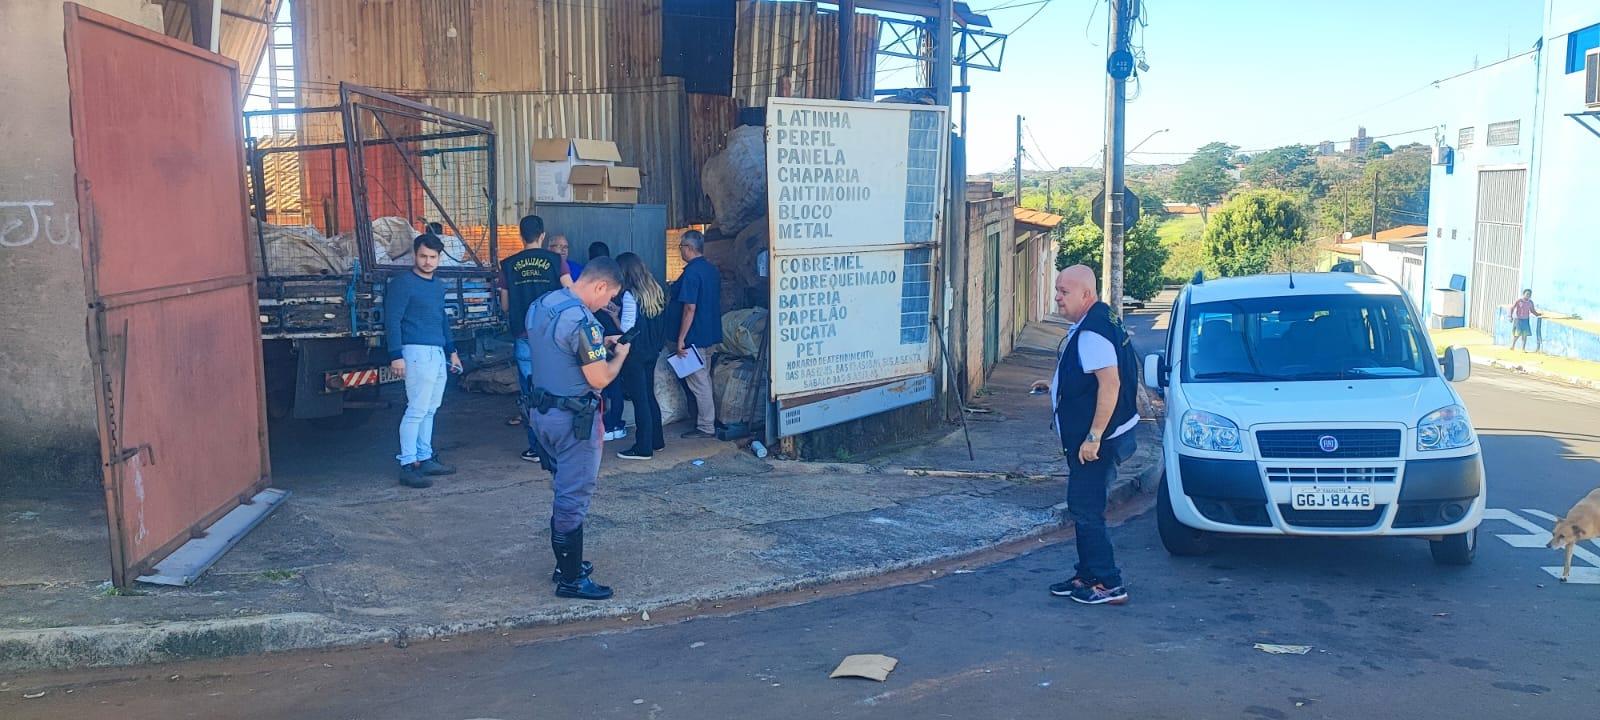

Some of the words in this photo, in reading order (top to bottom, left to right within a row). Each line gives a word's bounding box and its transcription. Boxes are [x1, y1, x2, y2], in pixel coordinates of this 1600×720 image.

[777, 109, 851, 128] LATINHA
[777, 129, 836, 147] PERFIL
[777, 148, 846, 165] PANELA
[777, 167, 860, 183] CHAPARIA
[779, 186, 871, 201] ANTIMONIO
[778, 204, 833, 220] BLOCO
[778, 223, 833, 239] METAL
[521, 269, 542, 277] GERAL
[779, 291, 841, 309] BATERIA
[778, 305, 848, 326] PAPELÃO
[780, 323, 837, 342] SUCATA
[797, 341, 824, 358] PET
